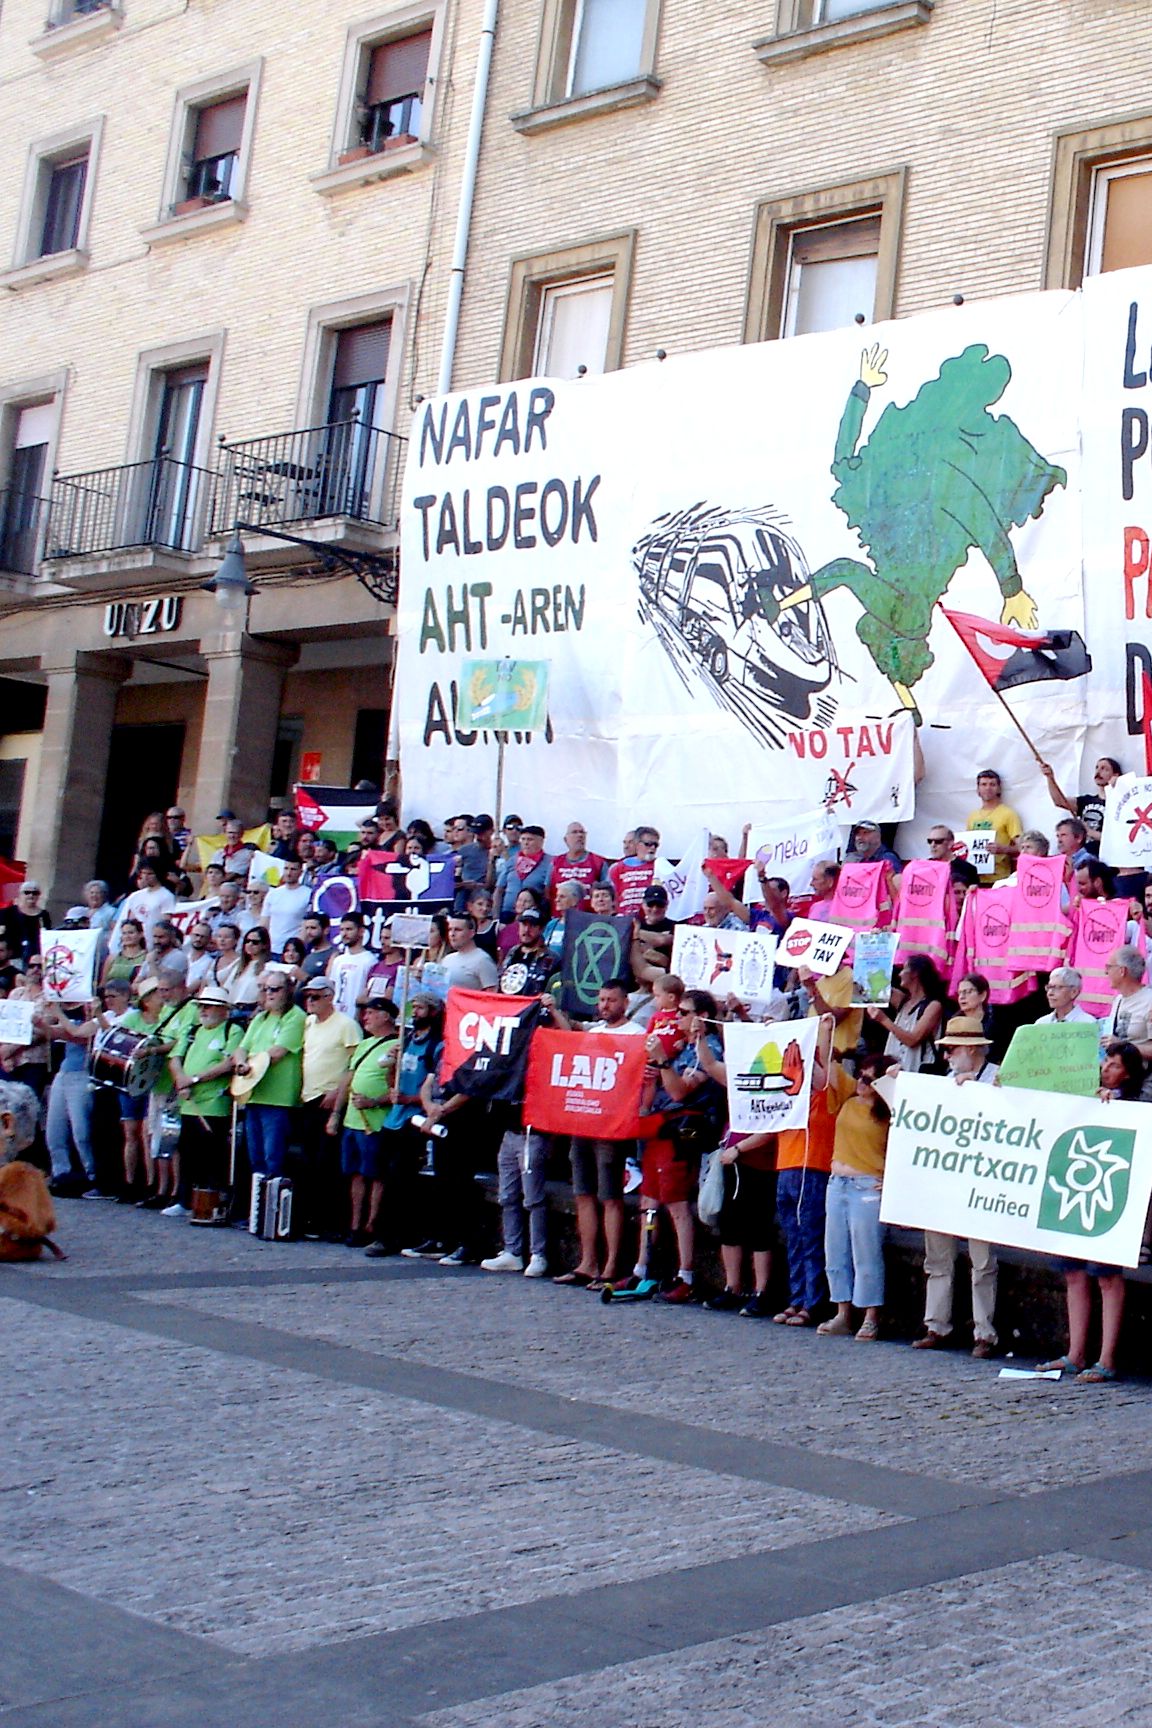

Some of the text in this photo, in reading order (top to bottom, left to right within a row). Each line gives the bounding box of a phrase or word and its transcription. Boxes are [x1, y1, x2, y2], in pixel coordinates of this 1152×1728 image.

[418, 385, 557, 468] NAFAR
[412, 474, 602, 562] TALDEOK
[788, 722, 896, 760] NO TAV
[973, 853, 990, 865] TAV
[812, 948, 834, 963] TAV
[818, 932, 843, 947] AHT
[458, 1011, 521, 1056] CNT
[550, 1052, 618, 1092] LAB
[911, 1145, 1039, 1187] martxan
[967, 1186, 1030, 1219] Iruñea
